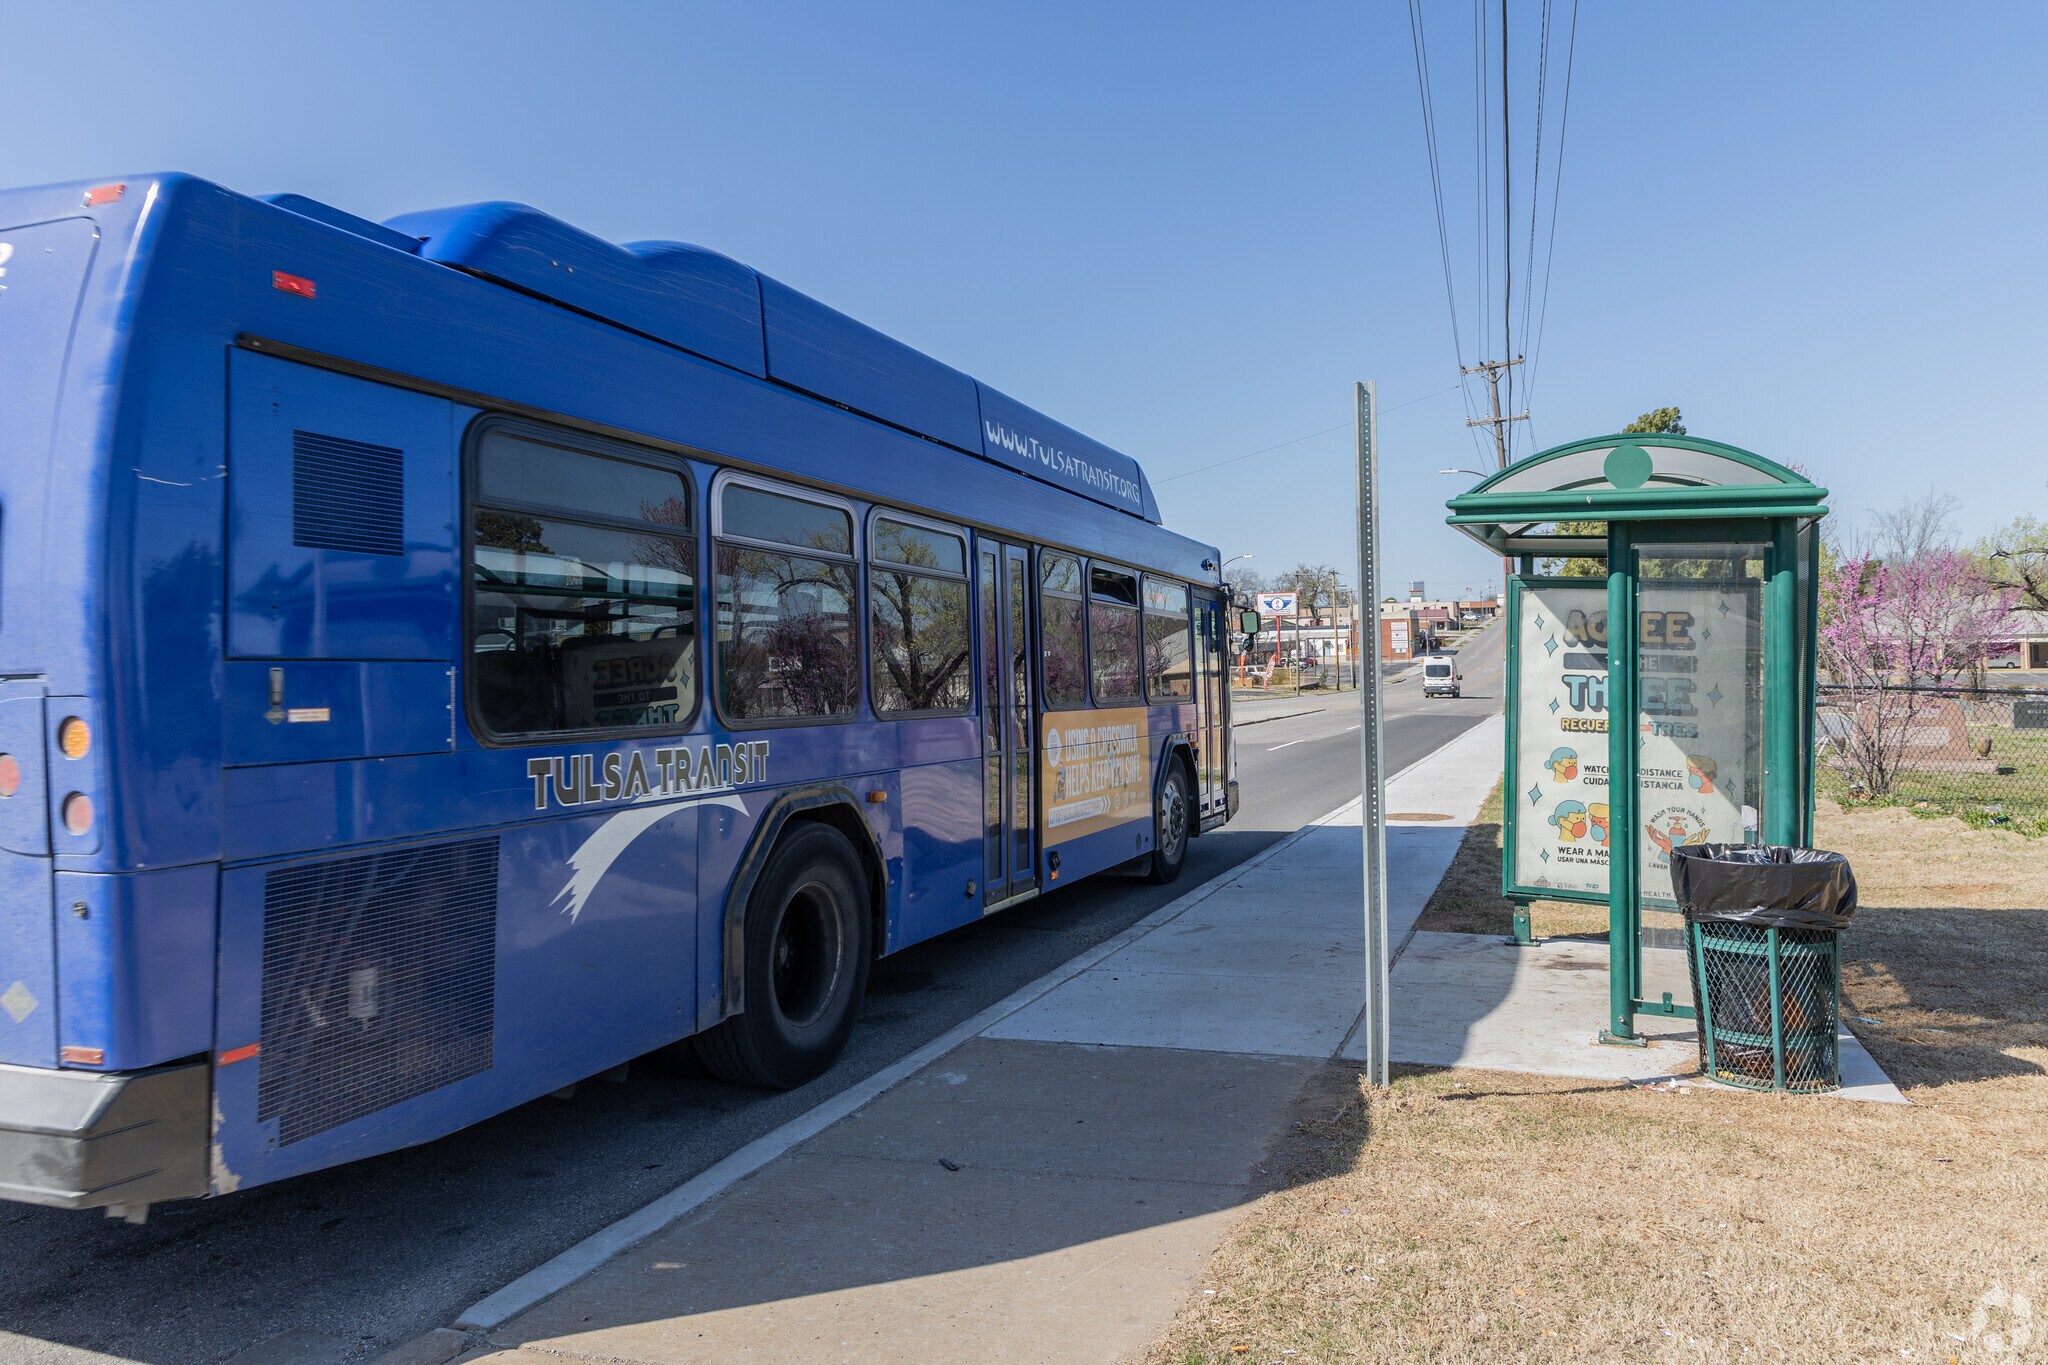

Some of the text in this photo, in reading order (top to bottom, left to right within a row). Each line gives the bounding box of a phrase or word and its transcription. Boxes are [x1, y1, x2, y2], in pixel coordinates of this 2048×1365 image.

[1562, 675, 1698, 717] THEE
[1648, 721, 1698, 738] TRES
[1065, 728, 1089, 762] USING
[1090, 728, 1096, 758] A
[1097, 724, 1139, 756] CROSSWALK
[527, 740, 769, 810] TULSA TRANSIT
[1065, 763, 1090, 798] HELPS
[1091, 760, 1109, 793] KEEP
[1640, 768, 1683, 778] DISTANCE
[1641, 780, 1684, 790] ISTANCIA
[1650, 809, 1666, 823] WASH
[1686, 809, 1706, 827] HANDS
[1558, 846, 1610, 858] WEAR A MA
[1575, 857, 1589, 865] UNA
[1648, 862, 1668, 870] LAVAR
